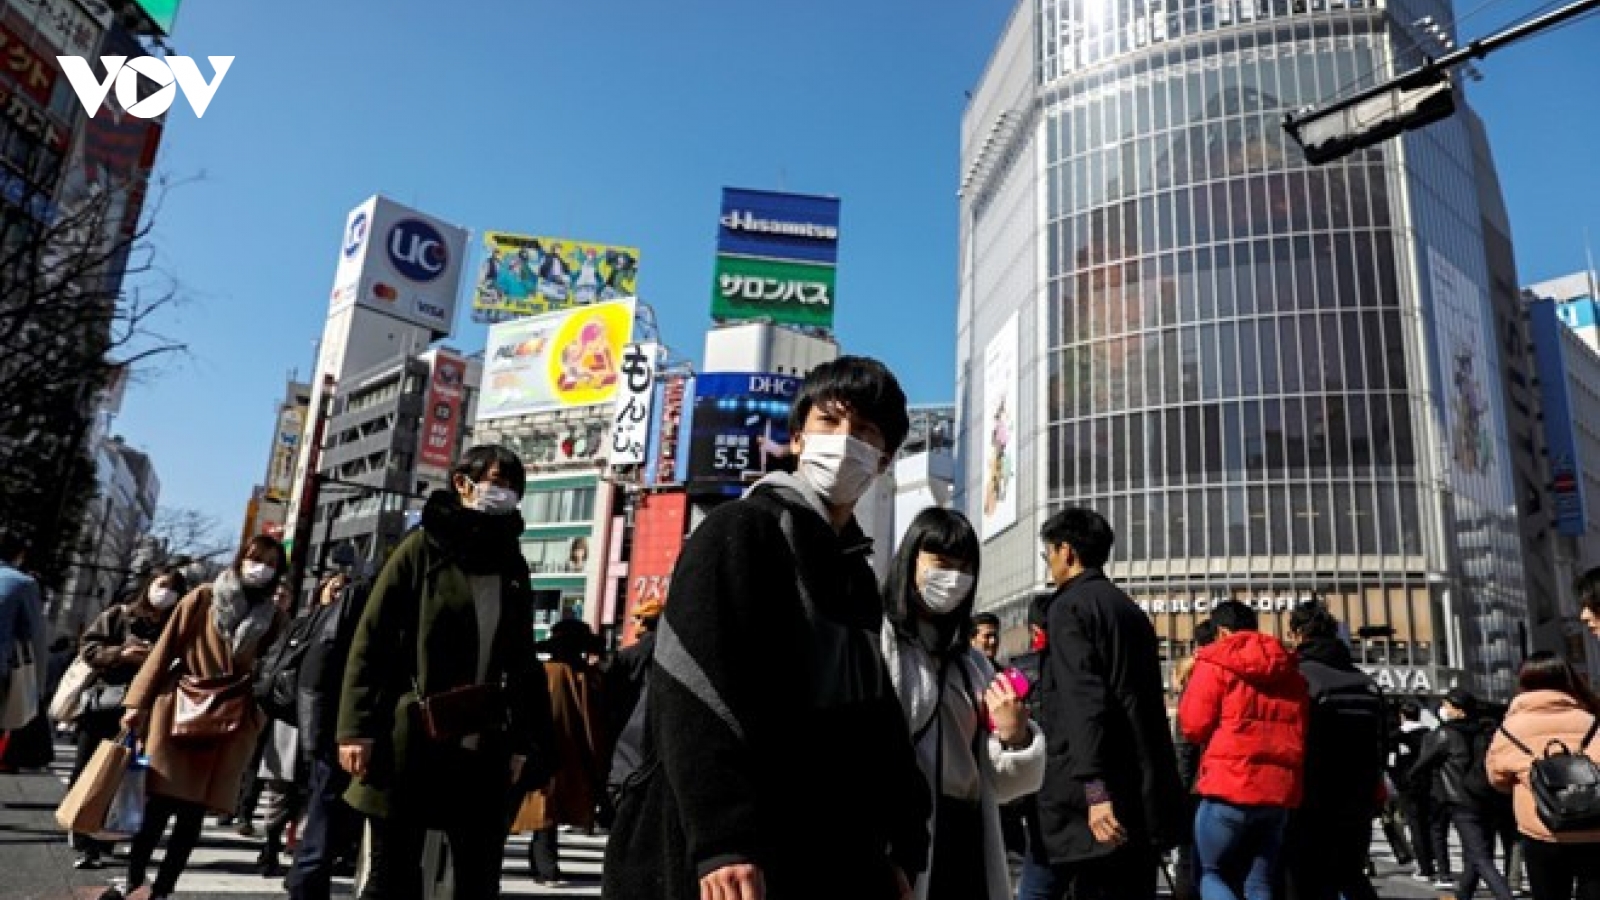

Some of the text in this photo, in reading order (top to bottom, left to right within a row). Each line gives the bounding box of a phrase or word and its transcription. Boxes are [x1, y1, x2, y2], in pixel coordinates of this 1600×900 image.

[719, 209, 837, 239] Hisamitsu
[392, 228, 442, 271] UC
[416, 301, 445, 319] VISA
[748, 375, 796, 396] DHC
[613, 344, 651, 460] もんじゃ
[713, 448, 750, 469] 5.5
